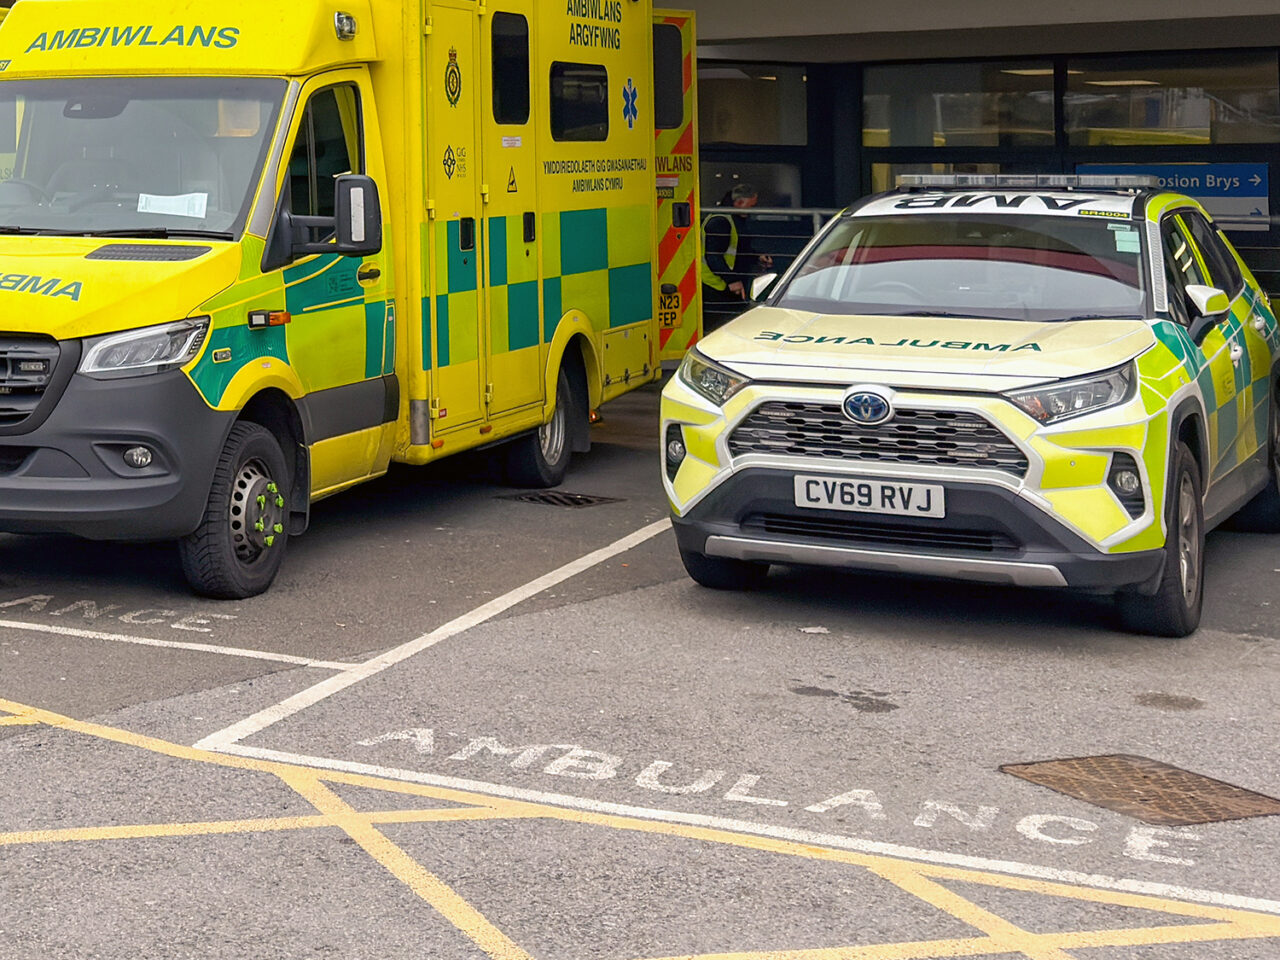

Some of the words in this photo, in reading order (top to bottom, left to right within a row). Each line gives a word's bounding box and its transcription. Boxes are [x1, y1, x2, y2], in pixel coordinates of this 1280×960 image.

[24, 25, 240, 53] AMBIWLANS
[569, 23, 620, 50] ARGYFWNG
[596, 160, 606, 173] GIG
[655, 156, 692, 172] IWLANS
[573, 178, 605, 192] AMBIWLANS
[605, 177, 624, 191] CYMRU
[1206, 174, 1240, 191] Brys
[1080, 210, 1129, 219] BR4004
[659, 295, 680, 310] N23
[805, 480, 872, 507] CV69
[880, 485, 932, 512] RVJ
[356, 726, 1202, 867] AMBULANCE
